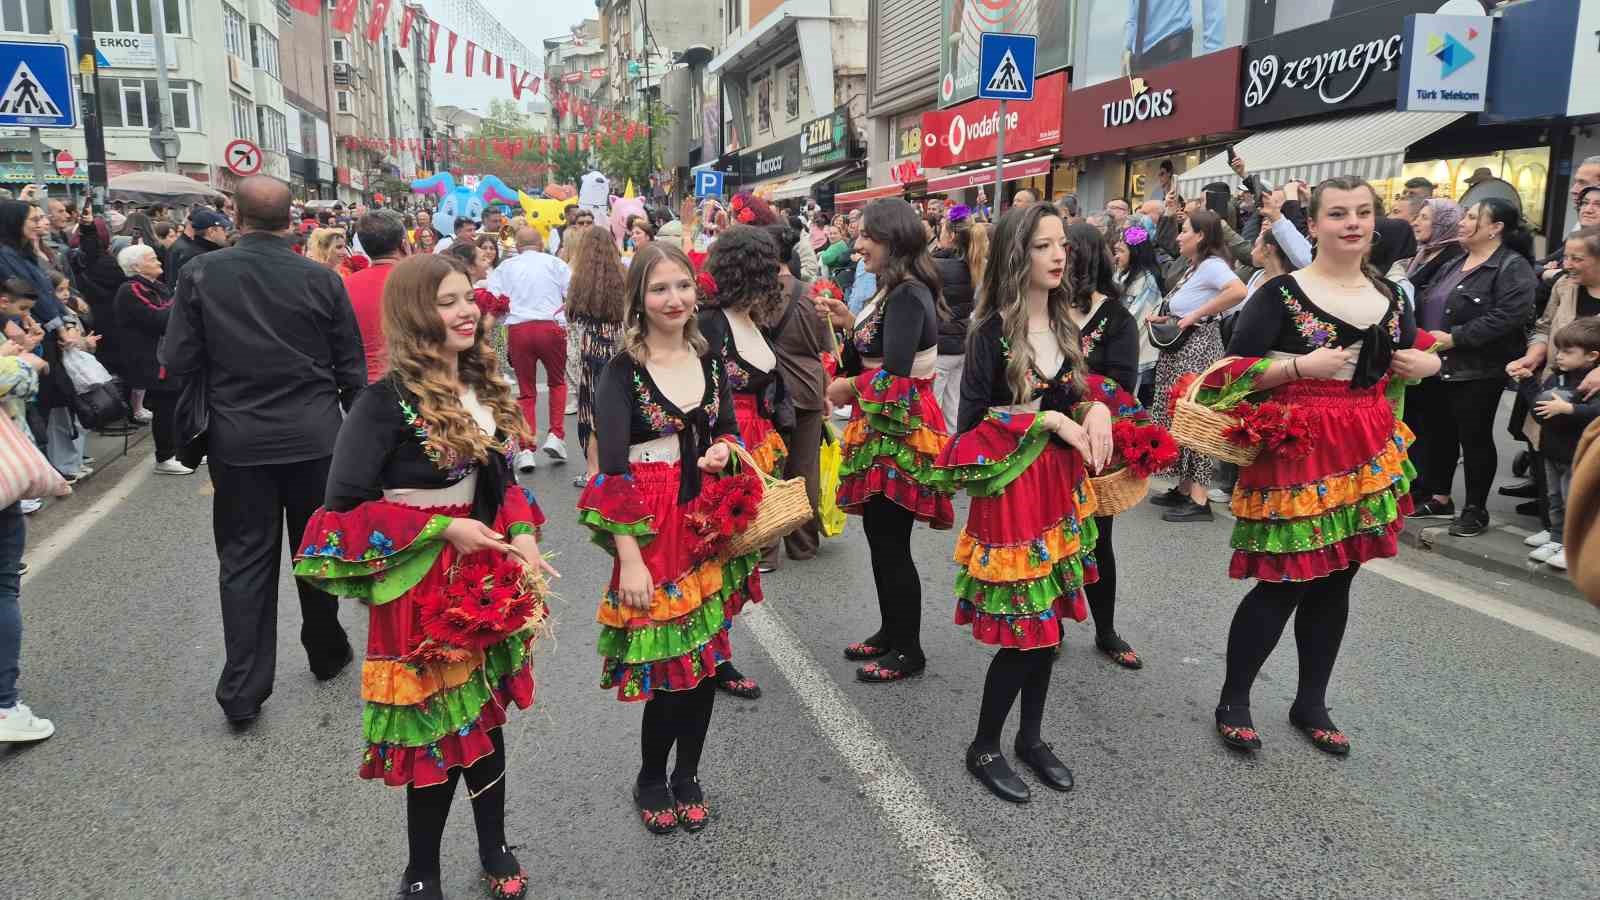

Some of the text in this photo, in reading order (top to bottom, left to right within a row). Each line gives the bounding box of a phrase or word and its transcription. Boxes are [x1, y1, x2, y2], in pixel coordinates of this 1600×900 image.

[1281, 34, 1403, 104] zeynepç
[1102, 88, 1173, 128] TUDORS
[1416, 89, 1479, 100] Türk Telekom
[701, 173, 717, 195] P
